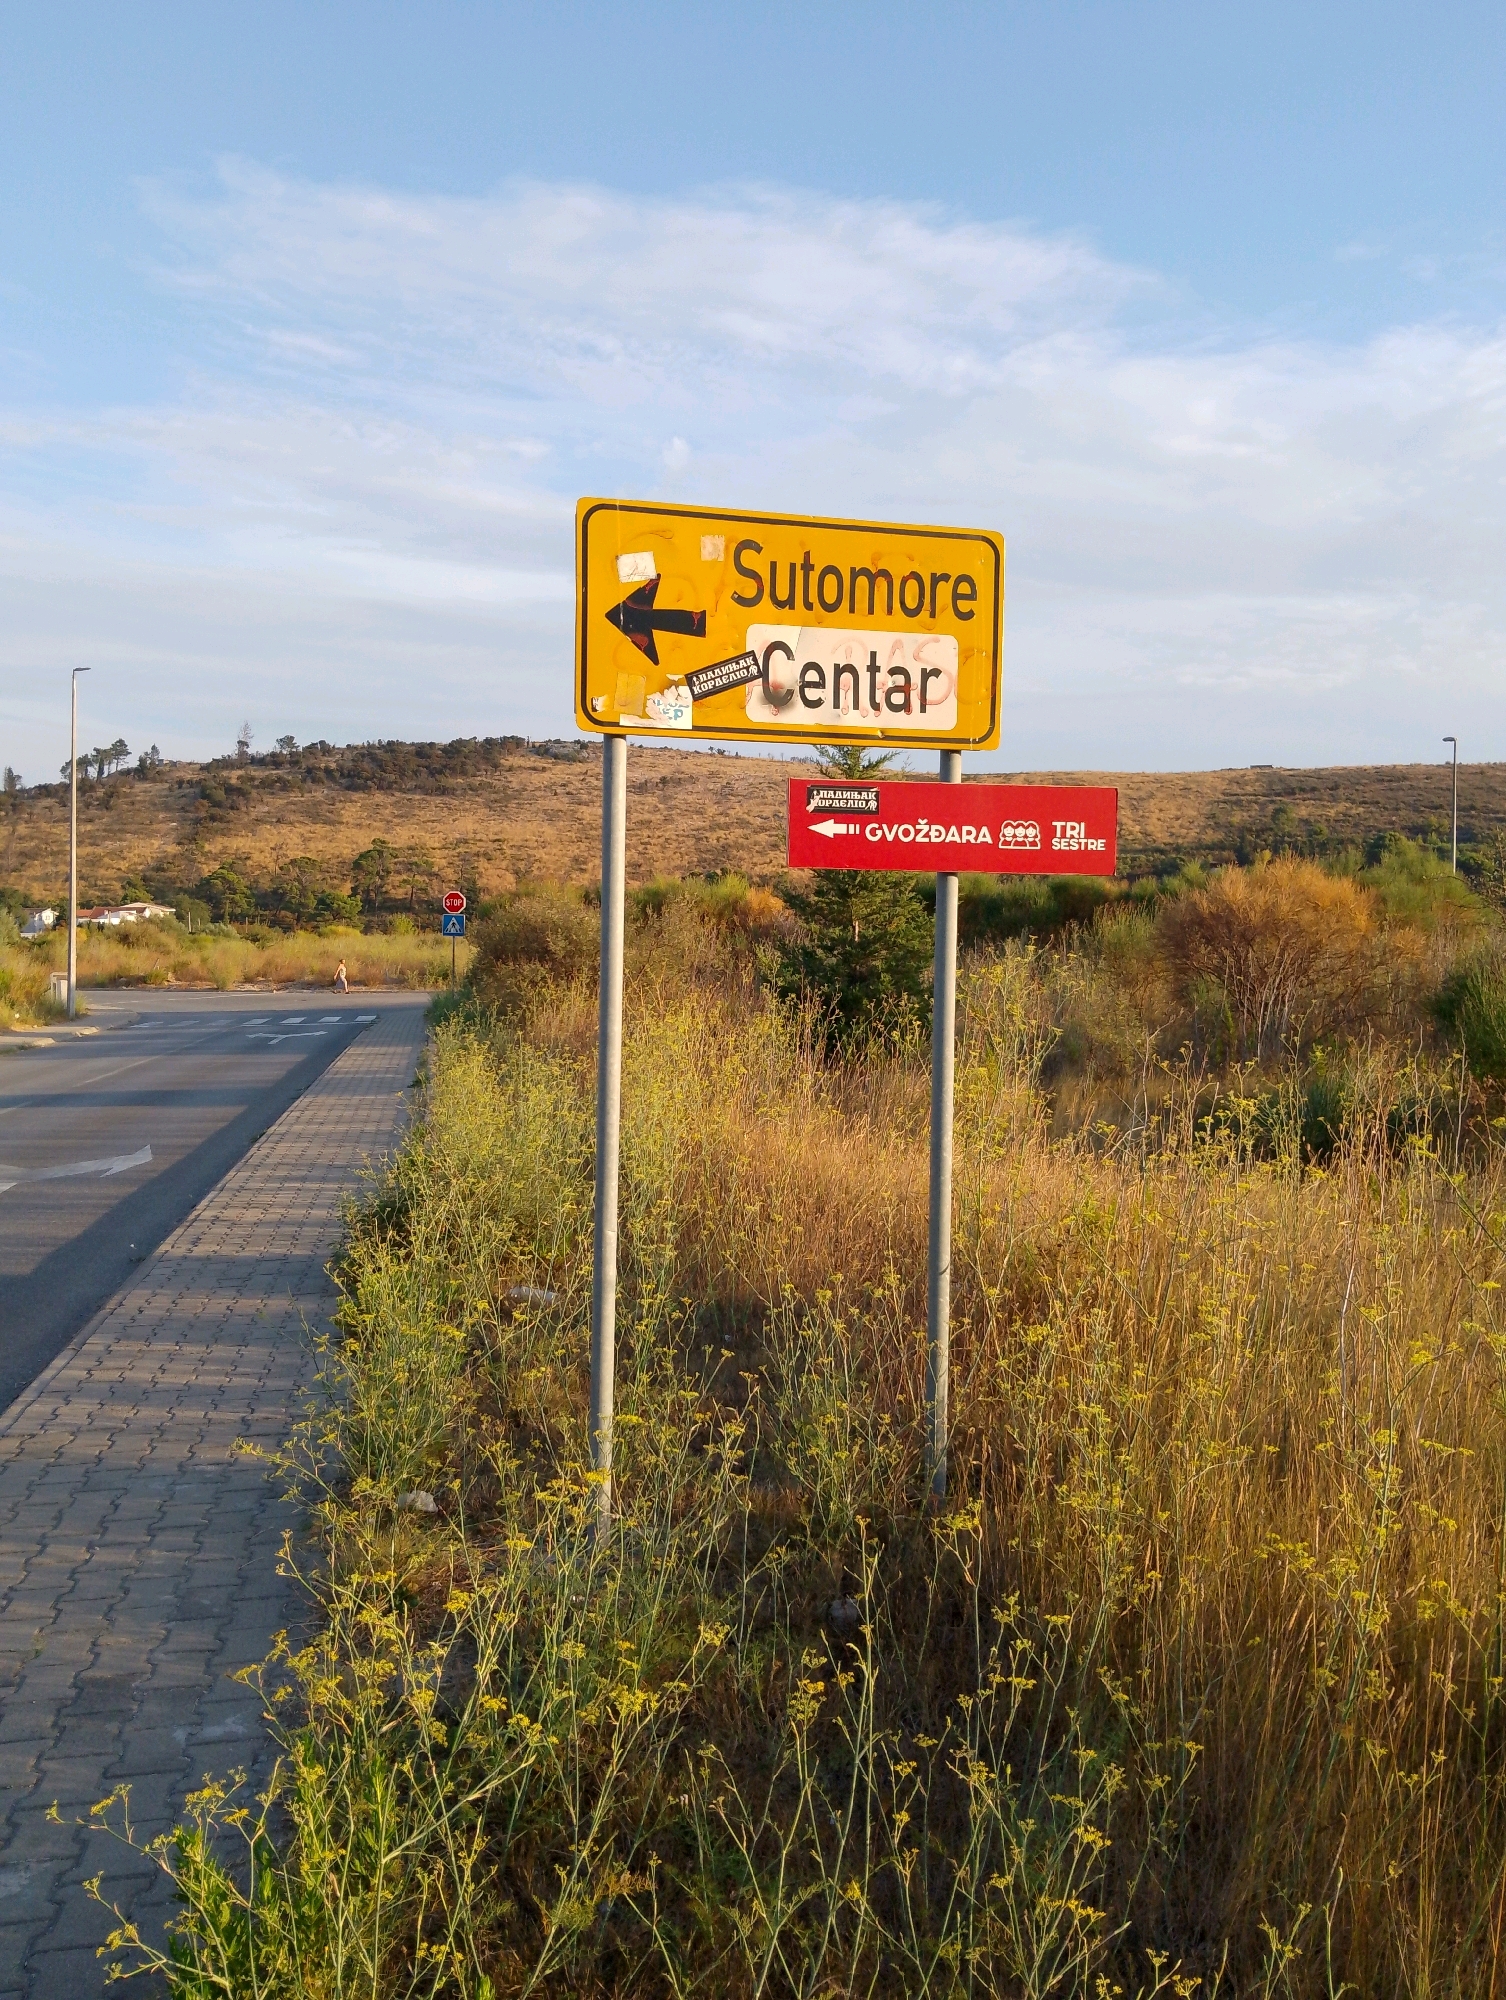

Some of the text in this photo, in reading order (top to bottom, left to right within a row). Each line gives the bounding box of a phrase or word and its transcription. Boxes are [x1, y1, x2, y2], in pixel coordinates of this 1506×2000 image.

[731, 539, 977, 621] Sutomore
[762, 641, 942, 714] Centar
[865, 818, 993, 844] GVOŽĐARA
[1052, 821, 1085, 839] TRI
[1051, 837, 1106, 851] SESTRE
[445, 898, 463, 906] STOP
